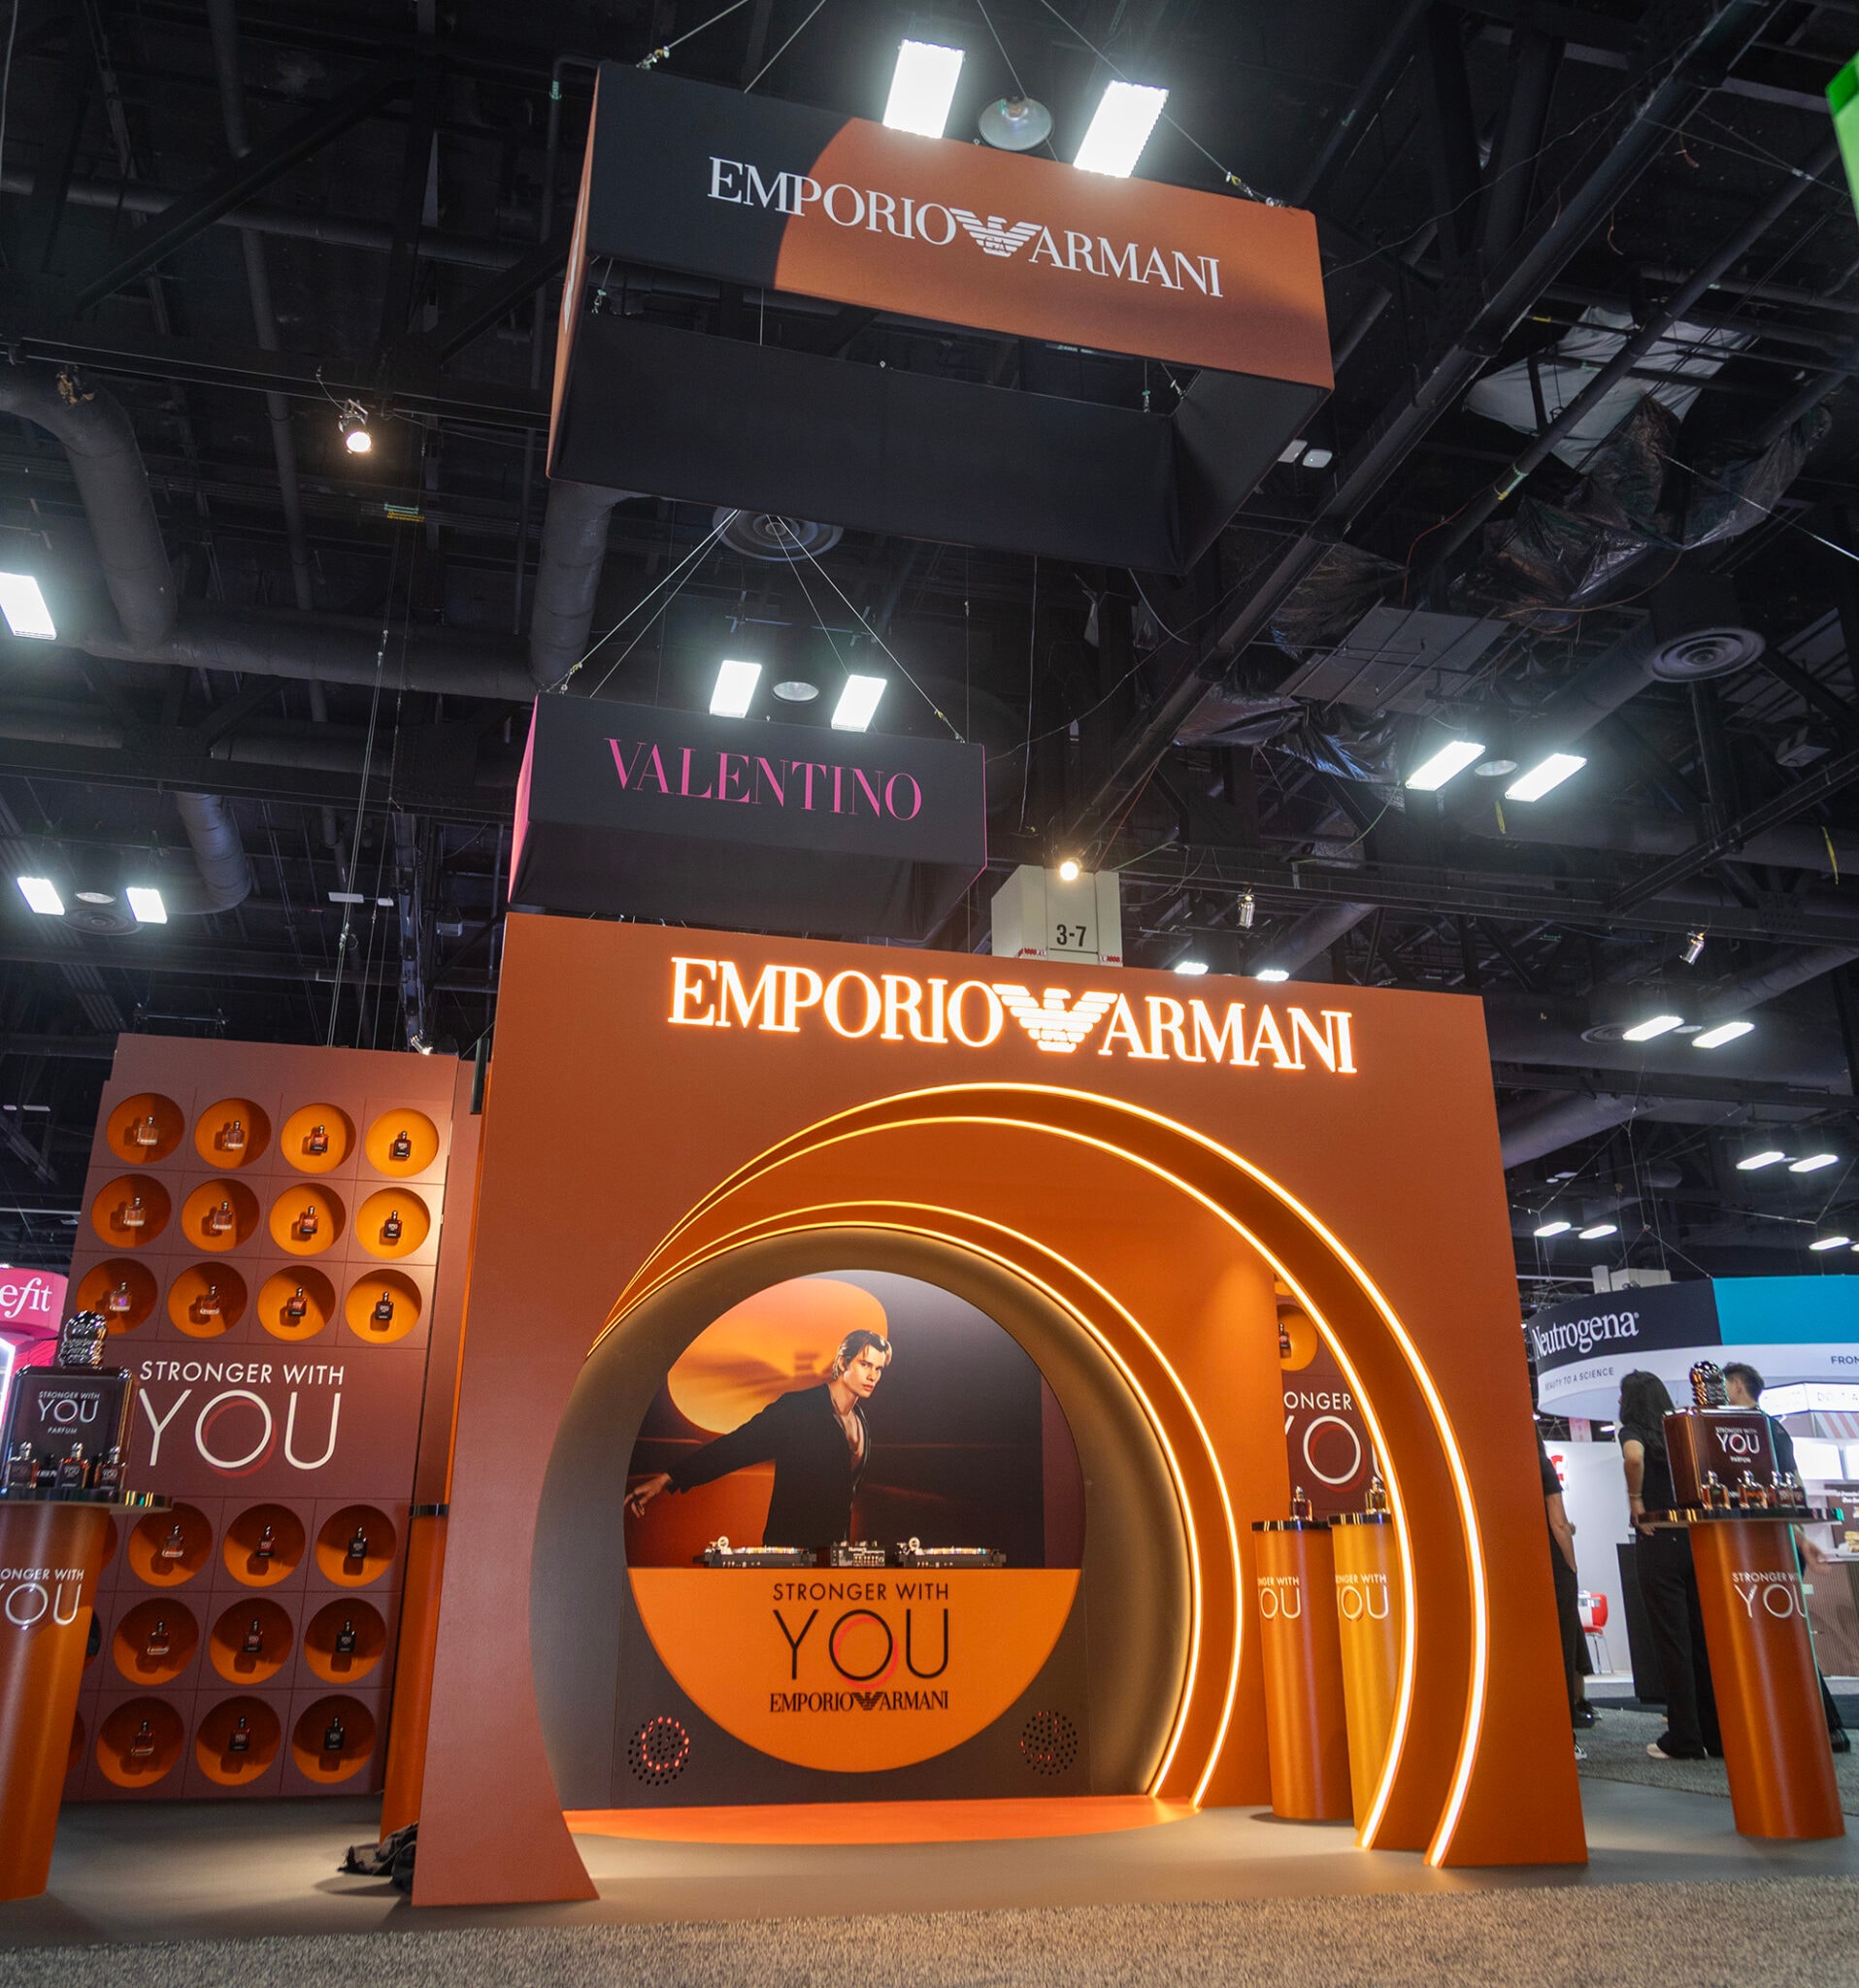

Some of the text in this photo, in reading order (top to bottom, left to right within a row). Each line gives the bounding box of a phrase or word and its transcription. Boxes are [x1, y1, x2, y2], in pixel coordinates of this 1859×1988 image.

[708, 156, 1223, 298] EMPORIO ARMANI
[604, 738, 922, 821] VALENTINO
[1056, 924, 1087, 947] 3-7
[668, 956, 1358, 1074] EMPORIO ARMANI
[1532, 1311, 1639, 1359] Neutrogena
[140, 1360, 345, 1385] STRONGER WITH
[1579, 1367, 1614, 1381] SCIENCE
[38, 1399, 99, 1423] YOU
[1283, 1391, 1352, 1410] ONGER
[139, 1388, 342, 1470] YOU
[1716, 1433, 1760, 1455] YOU
[54, 1569, 84, 1580] WITH
[1276, 1575, 1300, 1586] WITH
[1360, 1573, 1387, 1584] WITH
[1732, 1572, 1788, 1583] STRONGER
[773, 1582, 948, 1601] STRONGER WITH
[1258, 1587, 1301, 1618] OU
[1337, 1585, 1388, 1619] OU
[0, 1582, 82, 1626] OU
[773, 1607, 948, 1681] YOU
[769, 1690, 948, 1712] EMPORIO ARMANI
